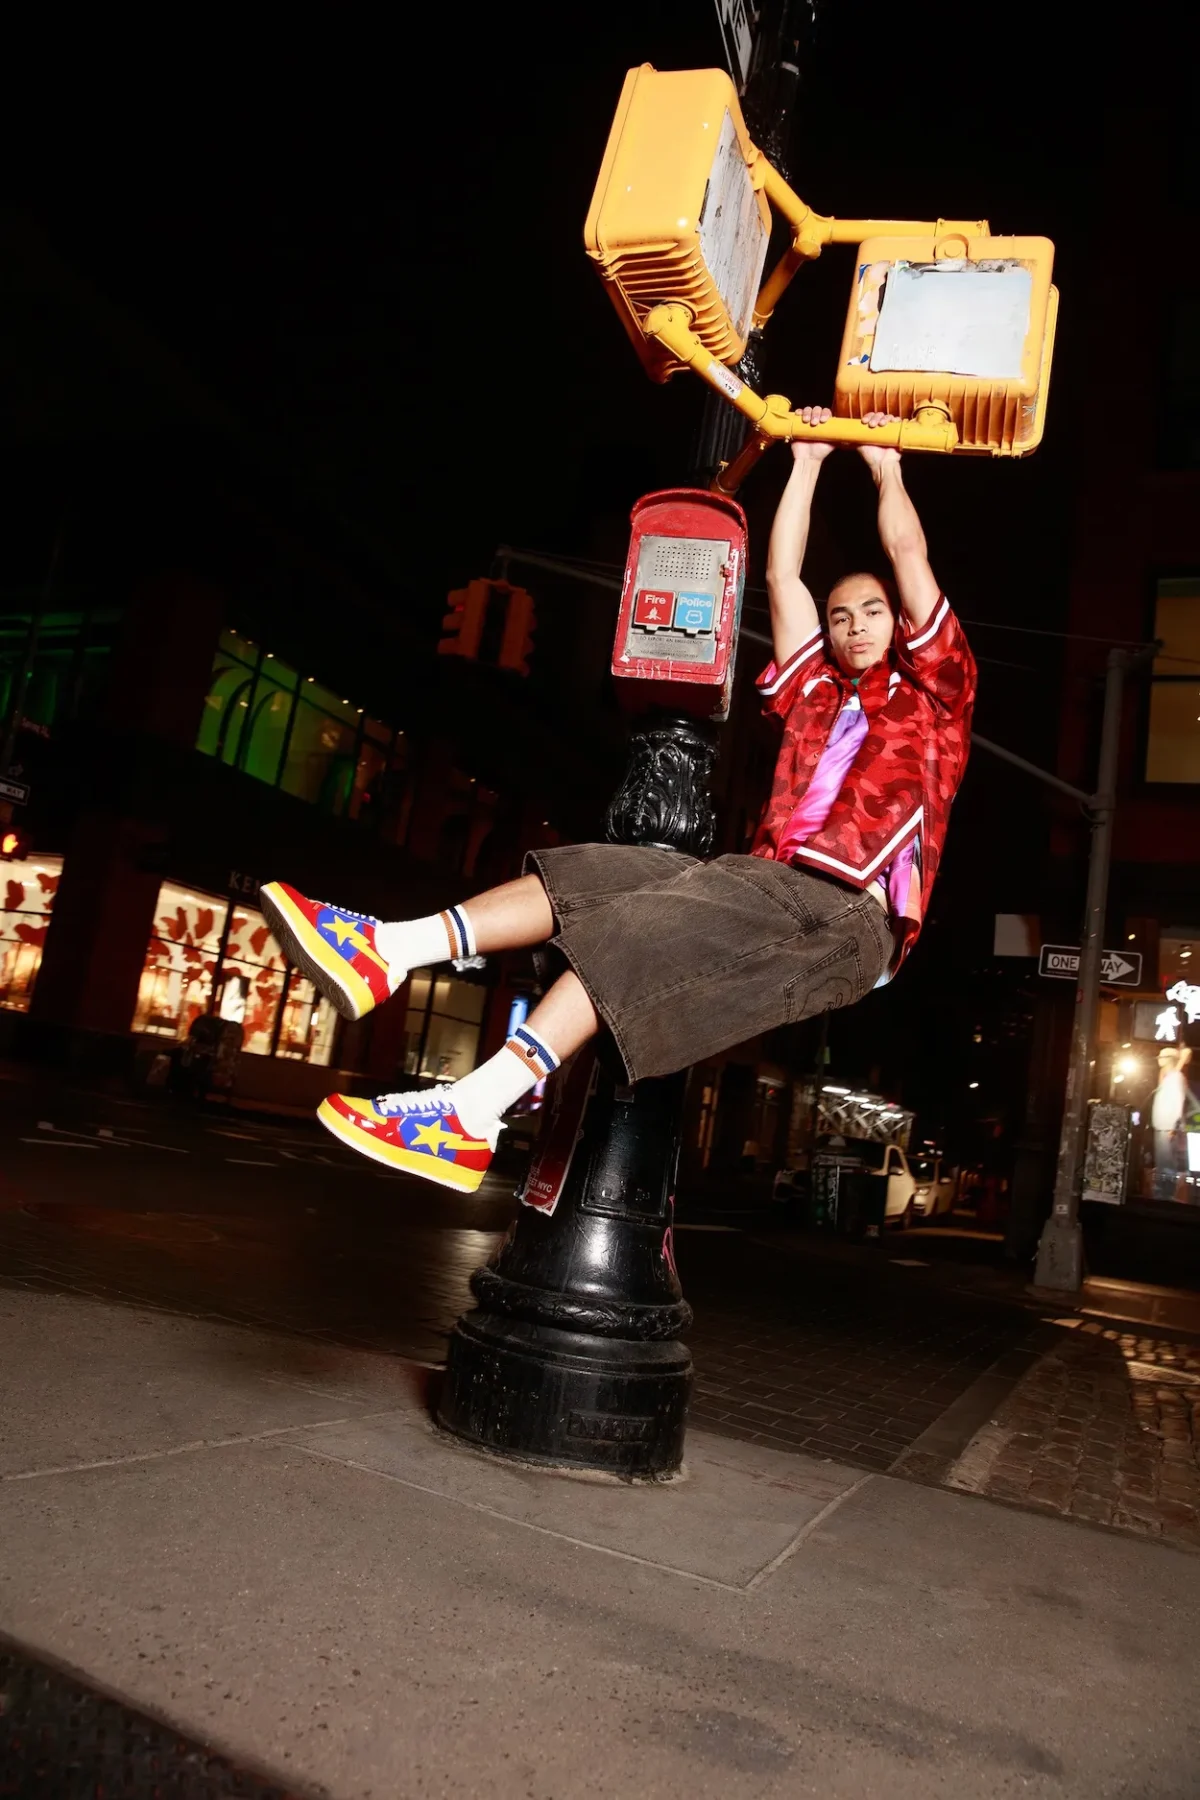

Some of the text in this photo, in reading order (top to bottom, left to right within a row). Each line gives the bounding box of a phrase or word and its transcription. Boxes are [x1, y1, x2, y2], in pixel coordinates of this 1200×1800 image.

[644, 594, 666, 605] Fire
[680, 597, 712, 608] Police
[1051, 955, 1078, 970] ONE
[538, 1181, 553, 1193] NYC
